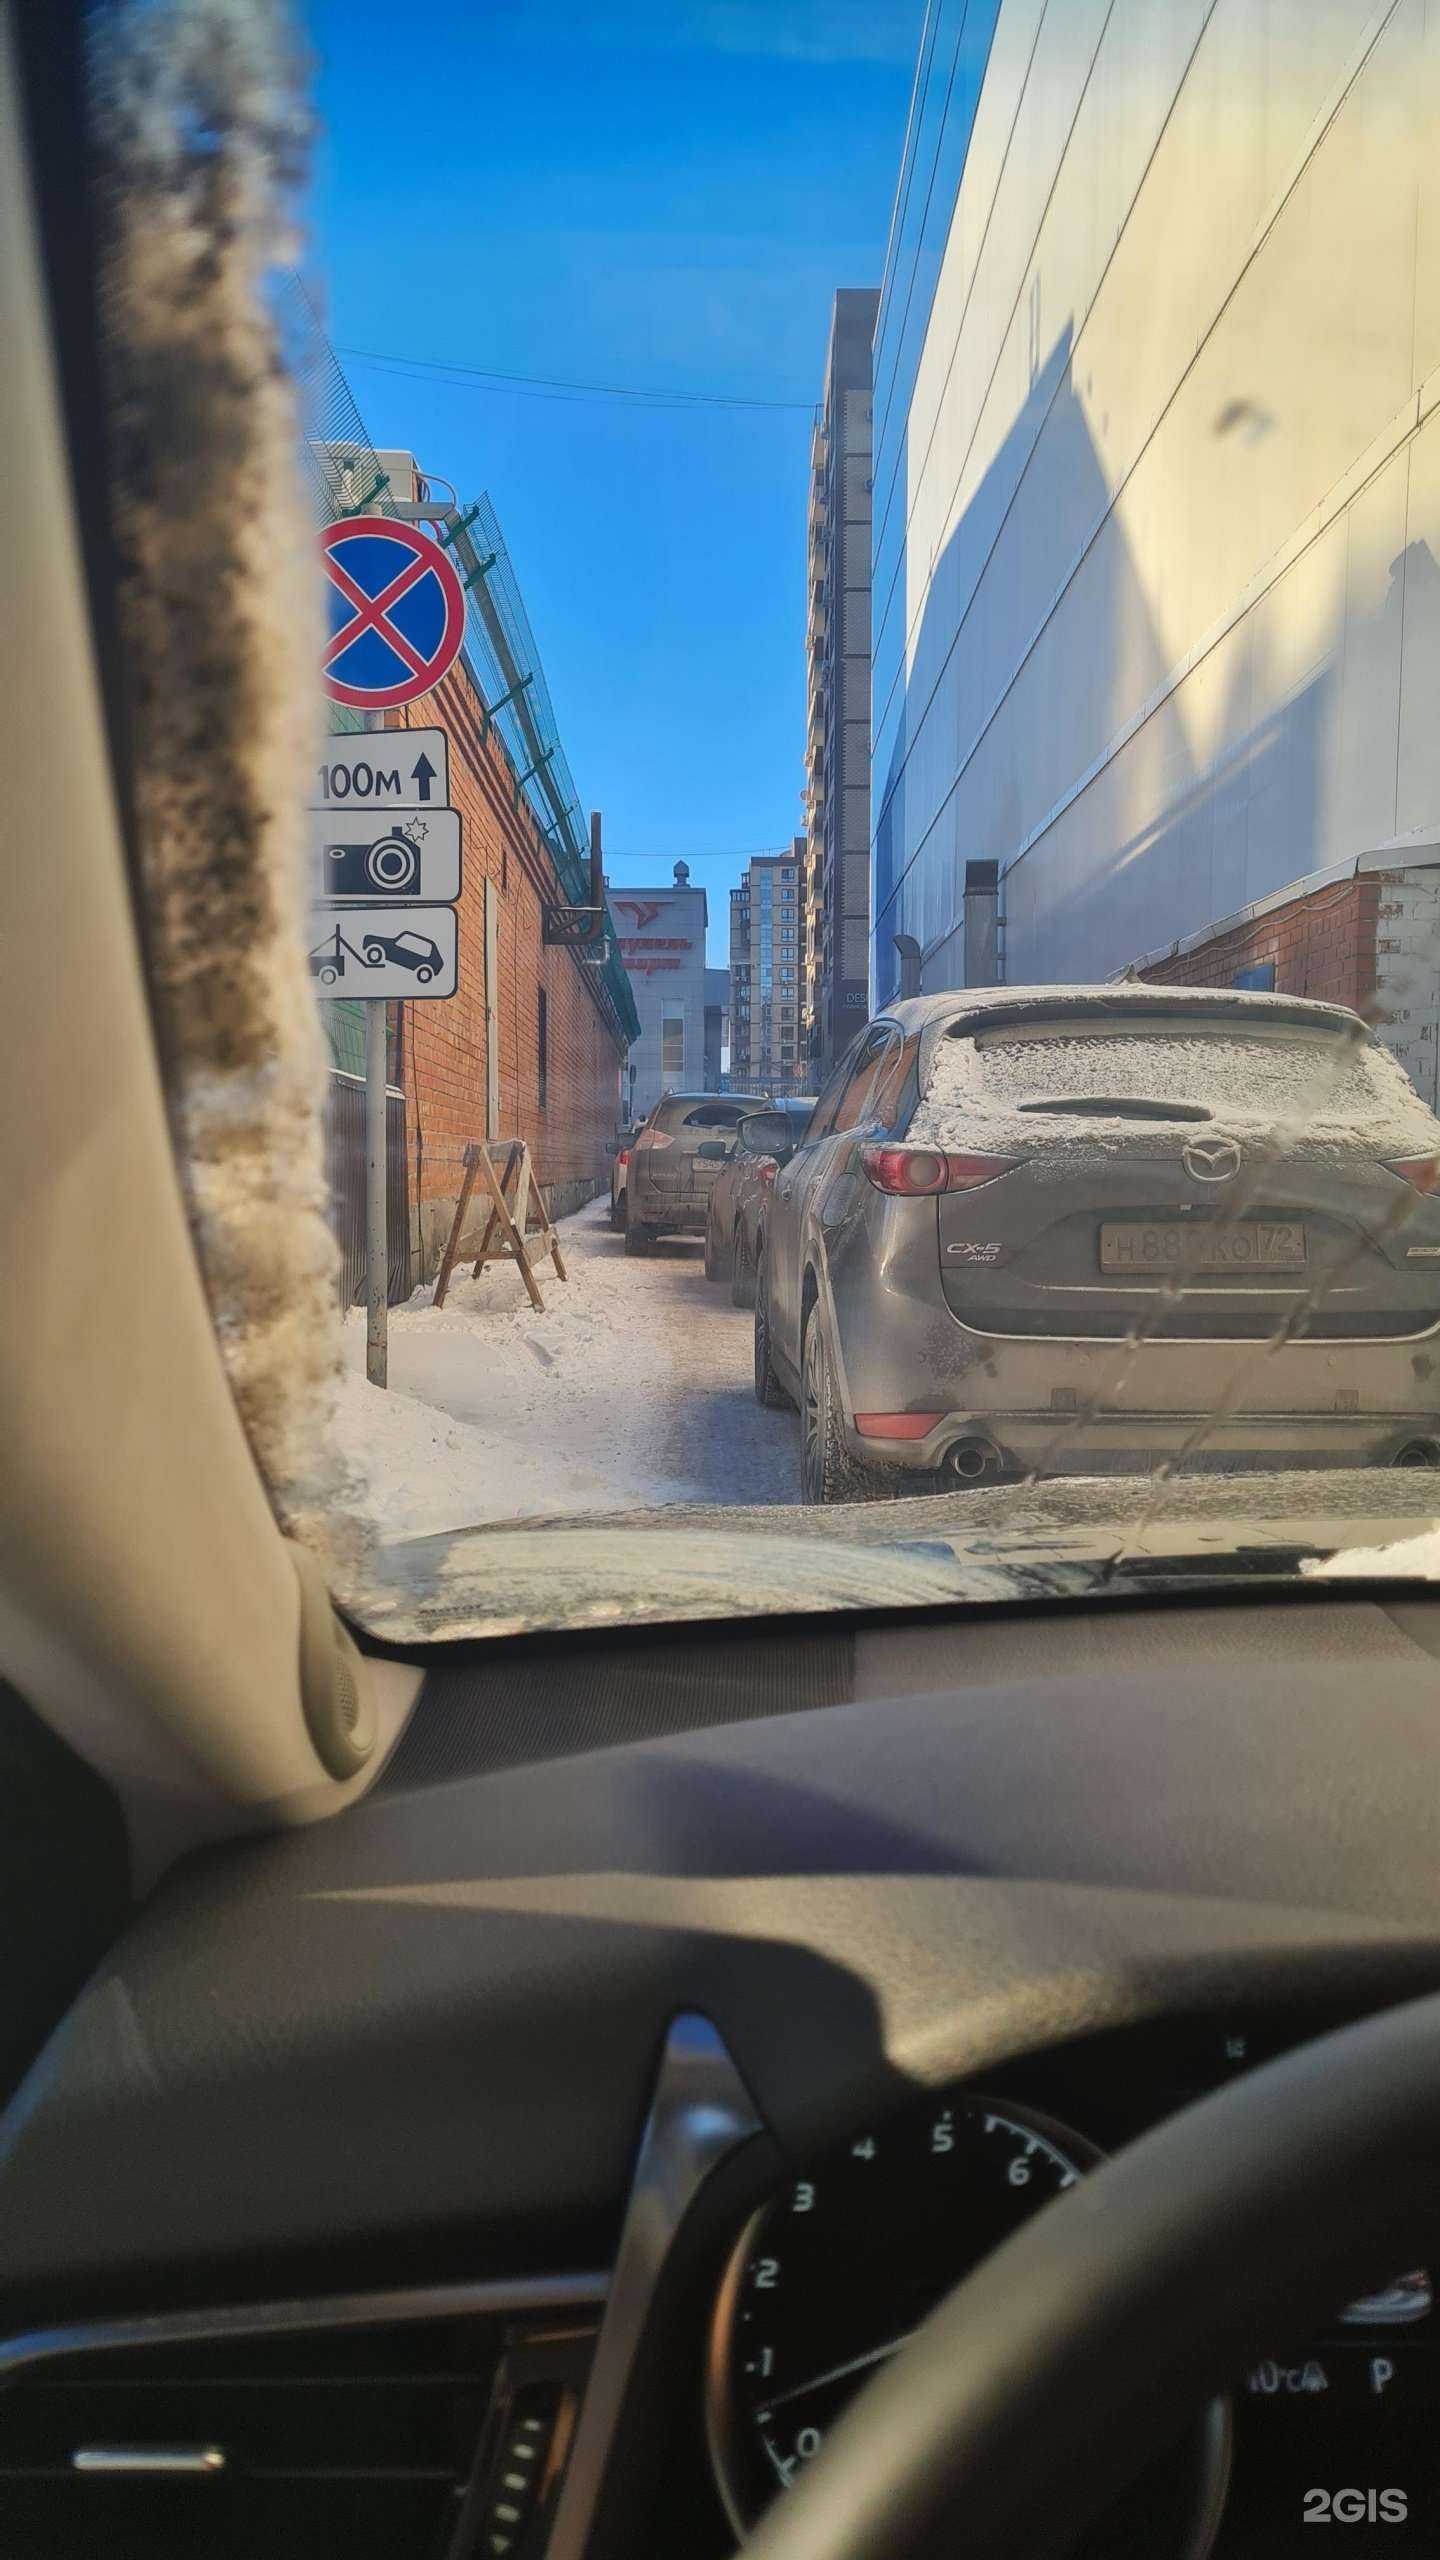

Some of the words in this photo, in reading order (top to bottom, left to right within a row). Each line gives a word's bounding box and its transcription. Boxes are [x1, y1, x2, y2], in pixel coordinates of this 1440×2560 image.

[946, 1243, 1002, 1254] CX-5
[967, 1254, 996, 1262] AWD
[852, 2137, 875, 2160] 4
[932, 2124, 954, 2152] 5
[1008, 2157, 1030, 2185] 6
[793, 2183, 815, 2211] 3
[755, 2259, 779, 2288] 2
[761, 2347, 773, 2376] 1
[1372, 2358, 1393, 2393] P
[797, 2428, 820, 2456] 0
